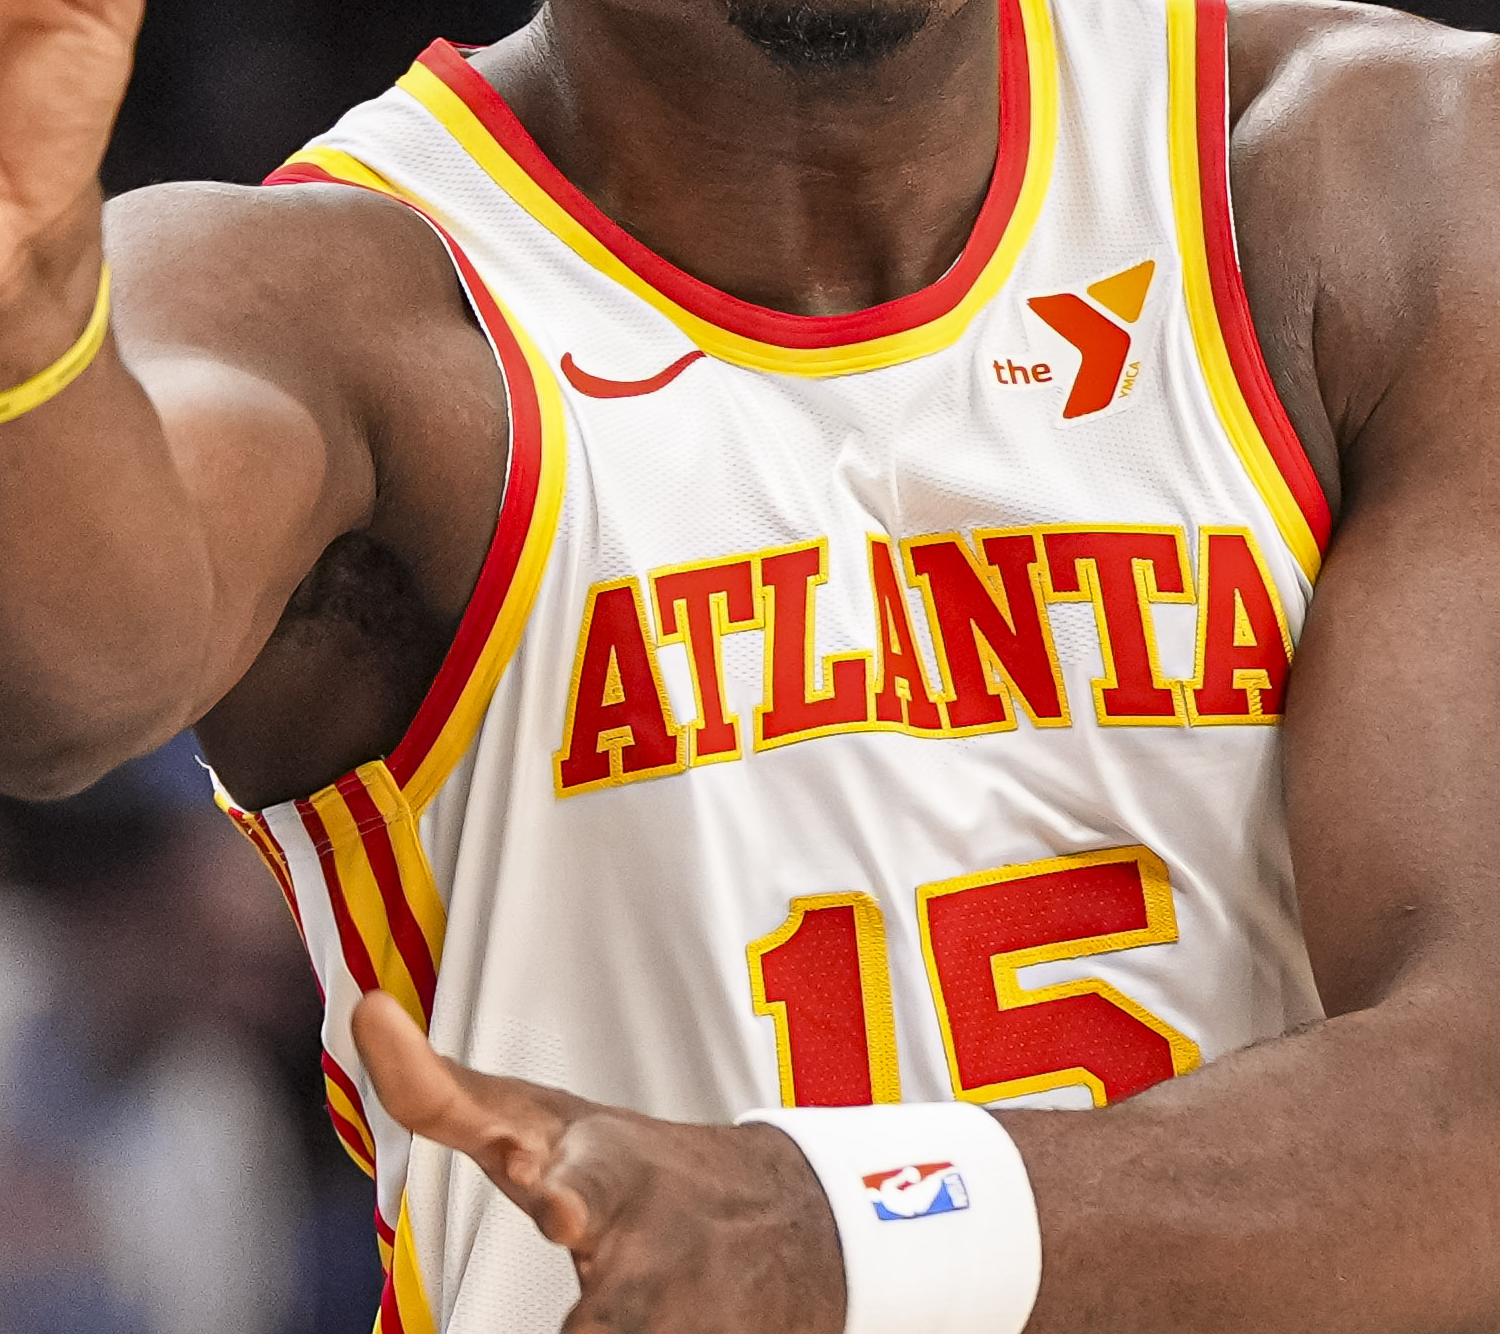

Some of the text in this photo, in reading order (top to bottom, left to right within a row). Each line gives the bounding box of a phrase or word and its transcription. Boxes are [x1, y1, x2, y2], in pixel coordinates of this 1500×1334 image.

[992, 358, 1053, 385] the
[1117, 360, 1141, 400] YMCA
[553, 523, 1294, 799] ATLANTA
[745, 844, 1203, 1109] 15
